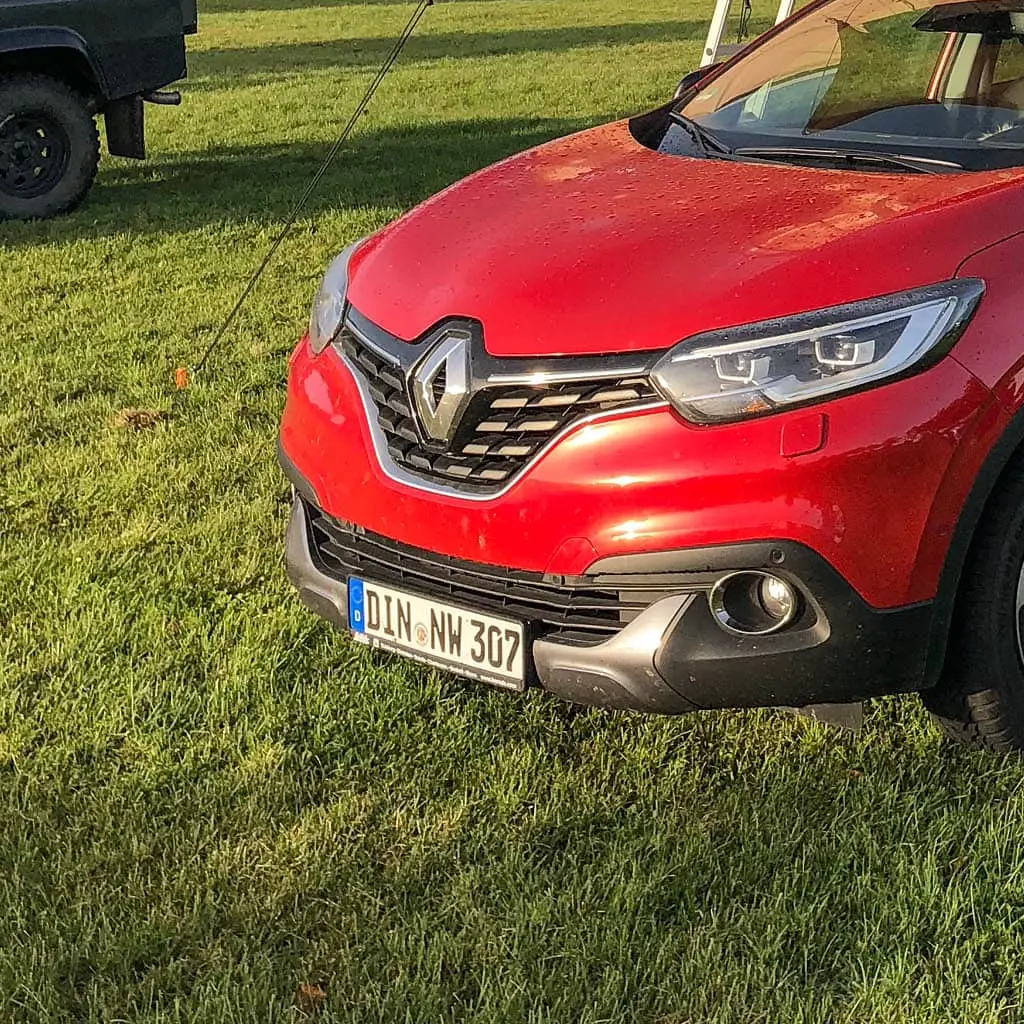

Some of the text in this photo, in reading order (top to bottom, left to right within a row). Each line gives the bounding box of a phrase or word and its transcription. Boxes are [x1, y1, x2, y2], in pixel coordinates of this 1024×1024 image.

[354, 609, 361, 622] D
[366, 589, 520, 673] DIN NW 307
